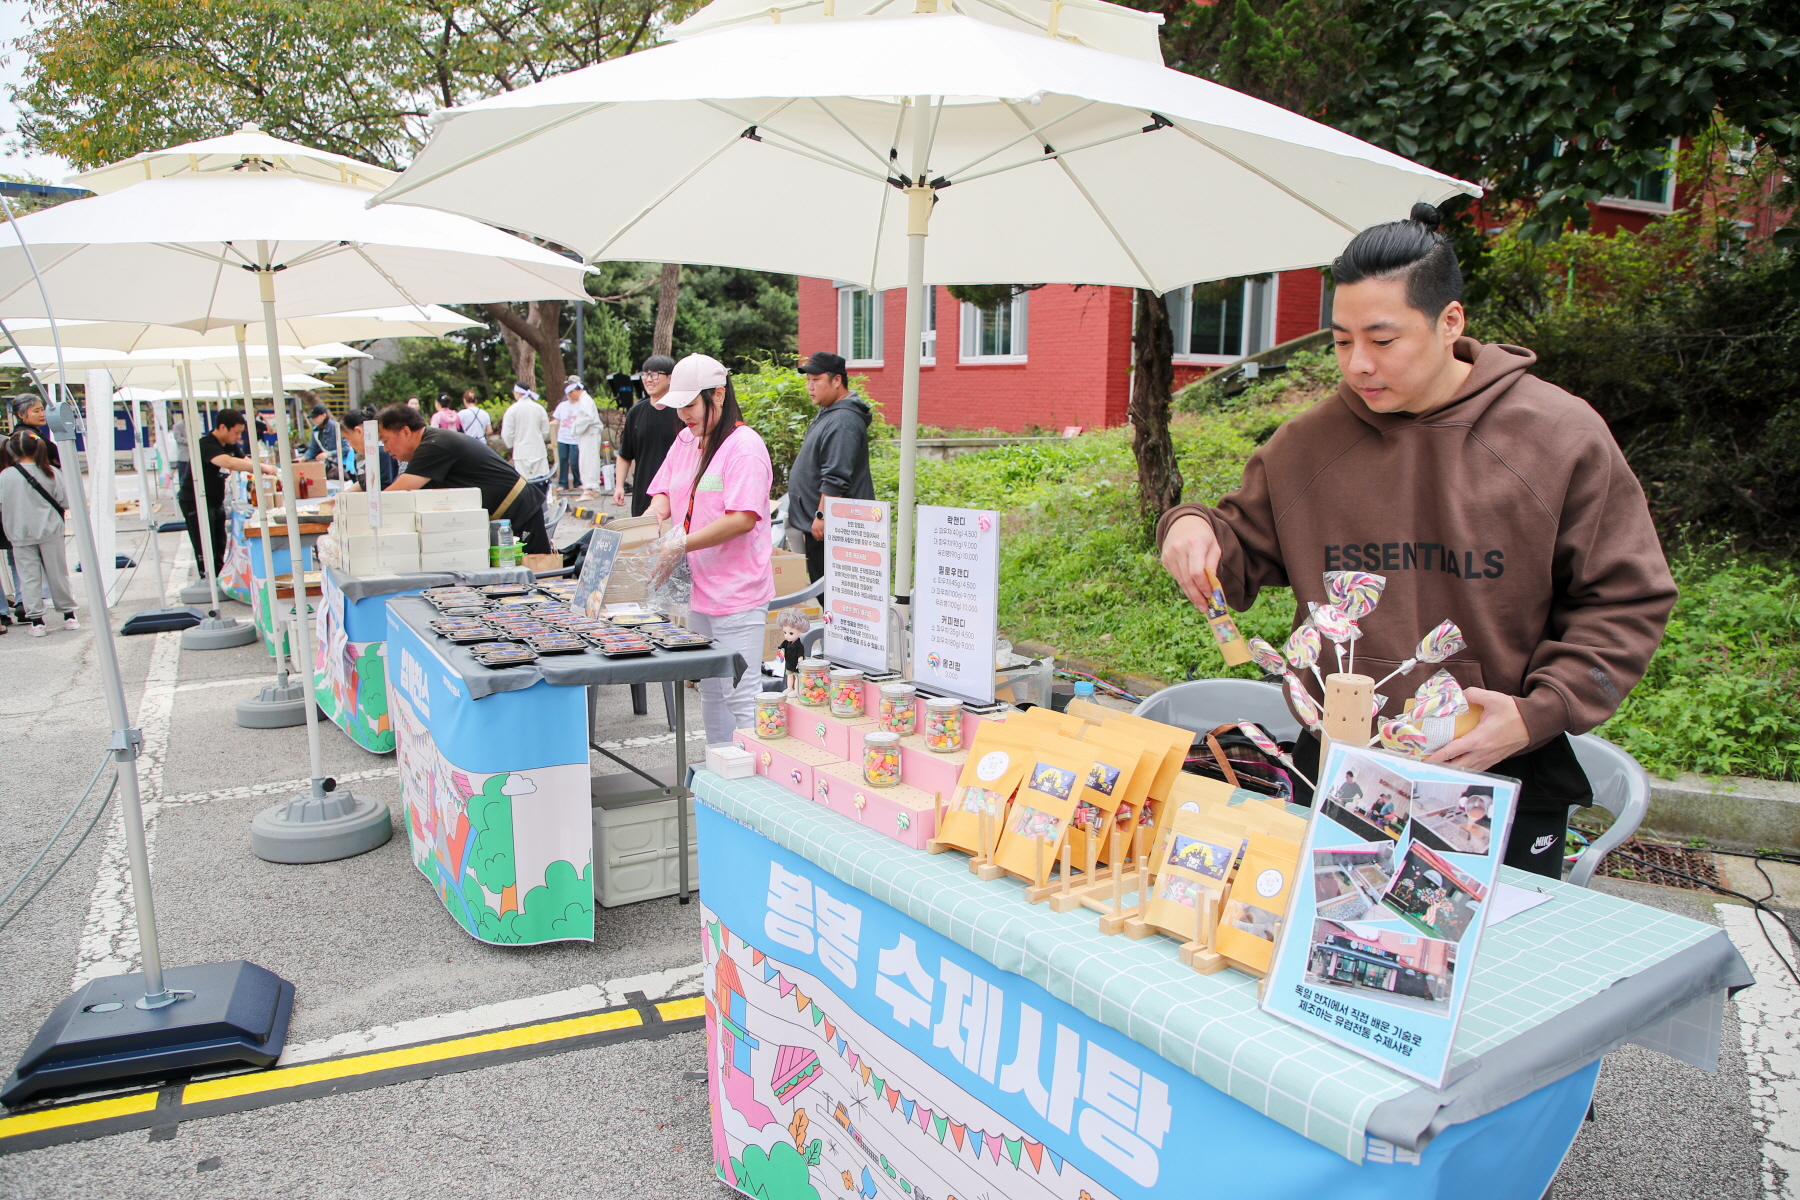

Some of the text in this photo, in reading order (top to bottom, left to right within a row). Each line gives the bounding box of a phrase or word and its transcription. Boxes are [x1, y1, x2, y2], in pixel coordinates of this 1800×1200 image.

[1324, 542, 1505, 579] ESSENTIALS
[1534, 834, 1554, 847] NIKE
[764, 860, 1172, 1188] 봉봉 수제사탕
[1295, 984, 1423, 1047] 독일 현지에서 직접 배운 기술로
[1298, 999, 1413, 1057] 제조하는 유럽전통 수제사탕
